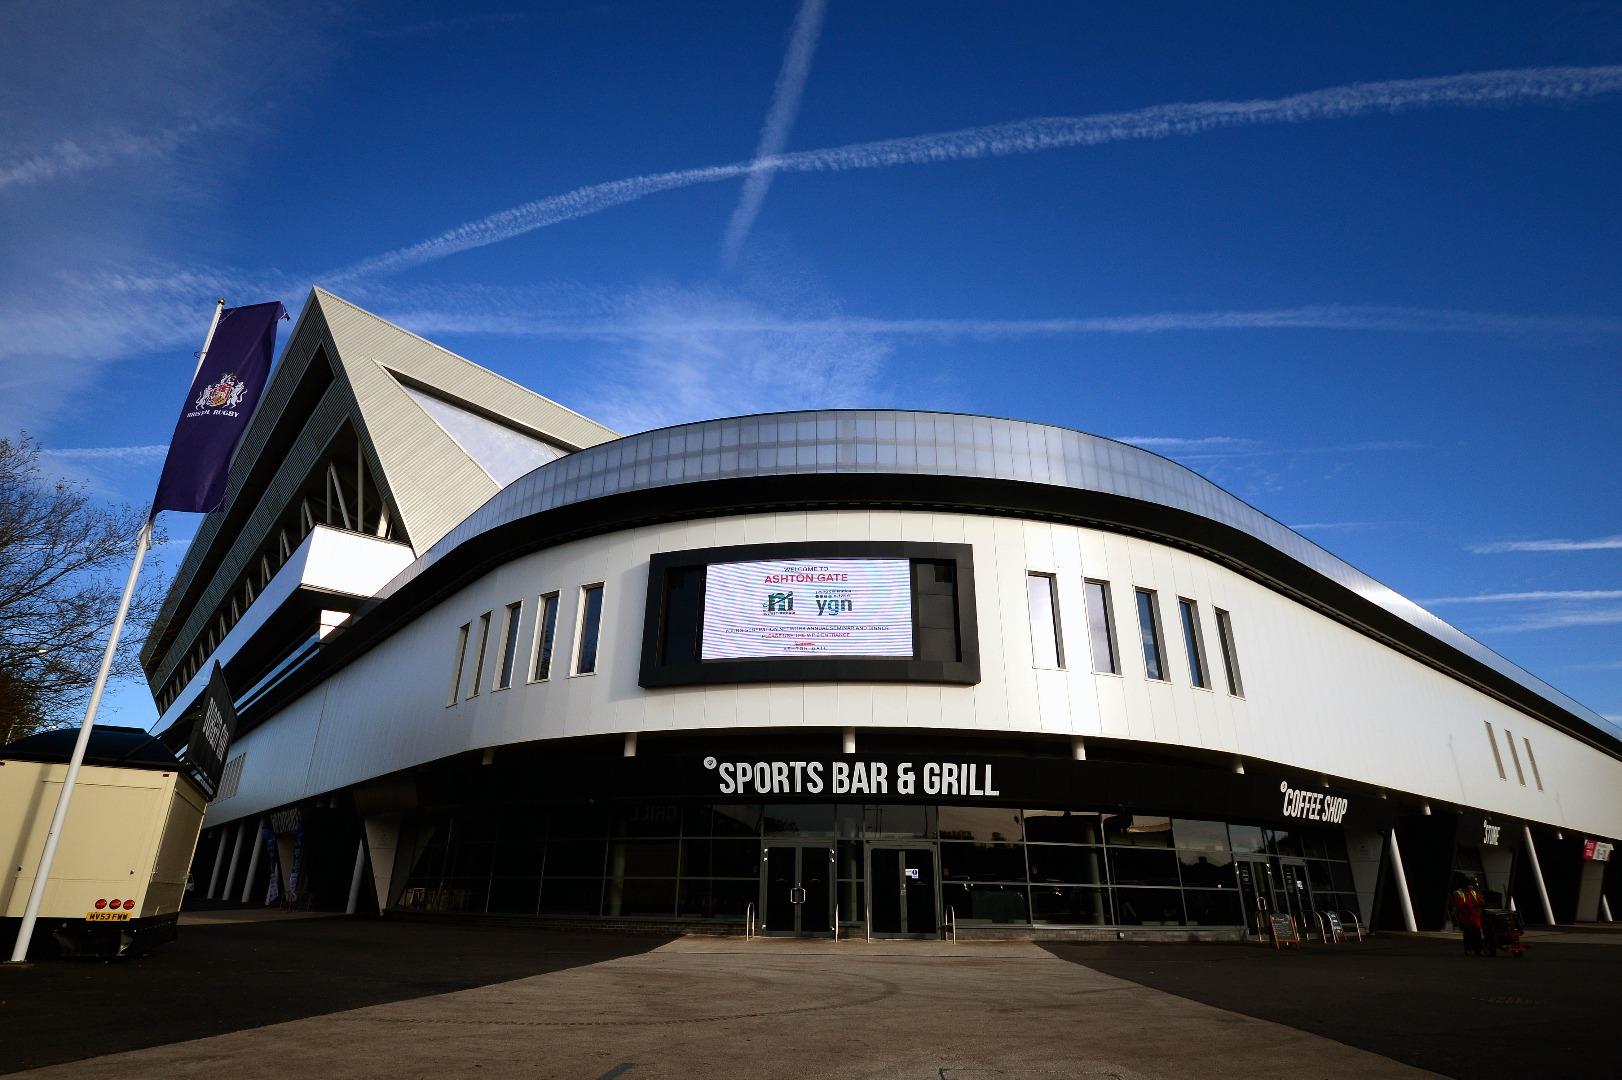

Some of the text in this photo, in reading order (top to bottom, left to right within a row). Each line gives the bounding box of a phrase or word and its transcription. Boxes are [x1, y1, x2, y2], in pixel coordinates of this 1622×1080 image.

[213, 409, 240, 418] RUGBY
[764, 573, 848, 584] ASHTON GATE
[815, 599, 853, 616] ygn
[719, 761, 1000, 797] SPORTS BAR & GRILL
[1283, 788, 1348, 824] COFFEE SHOP
